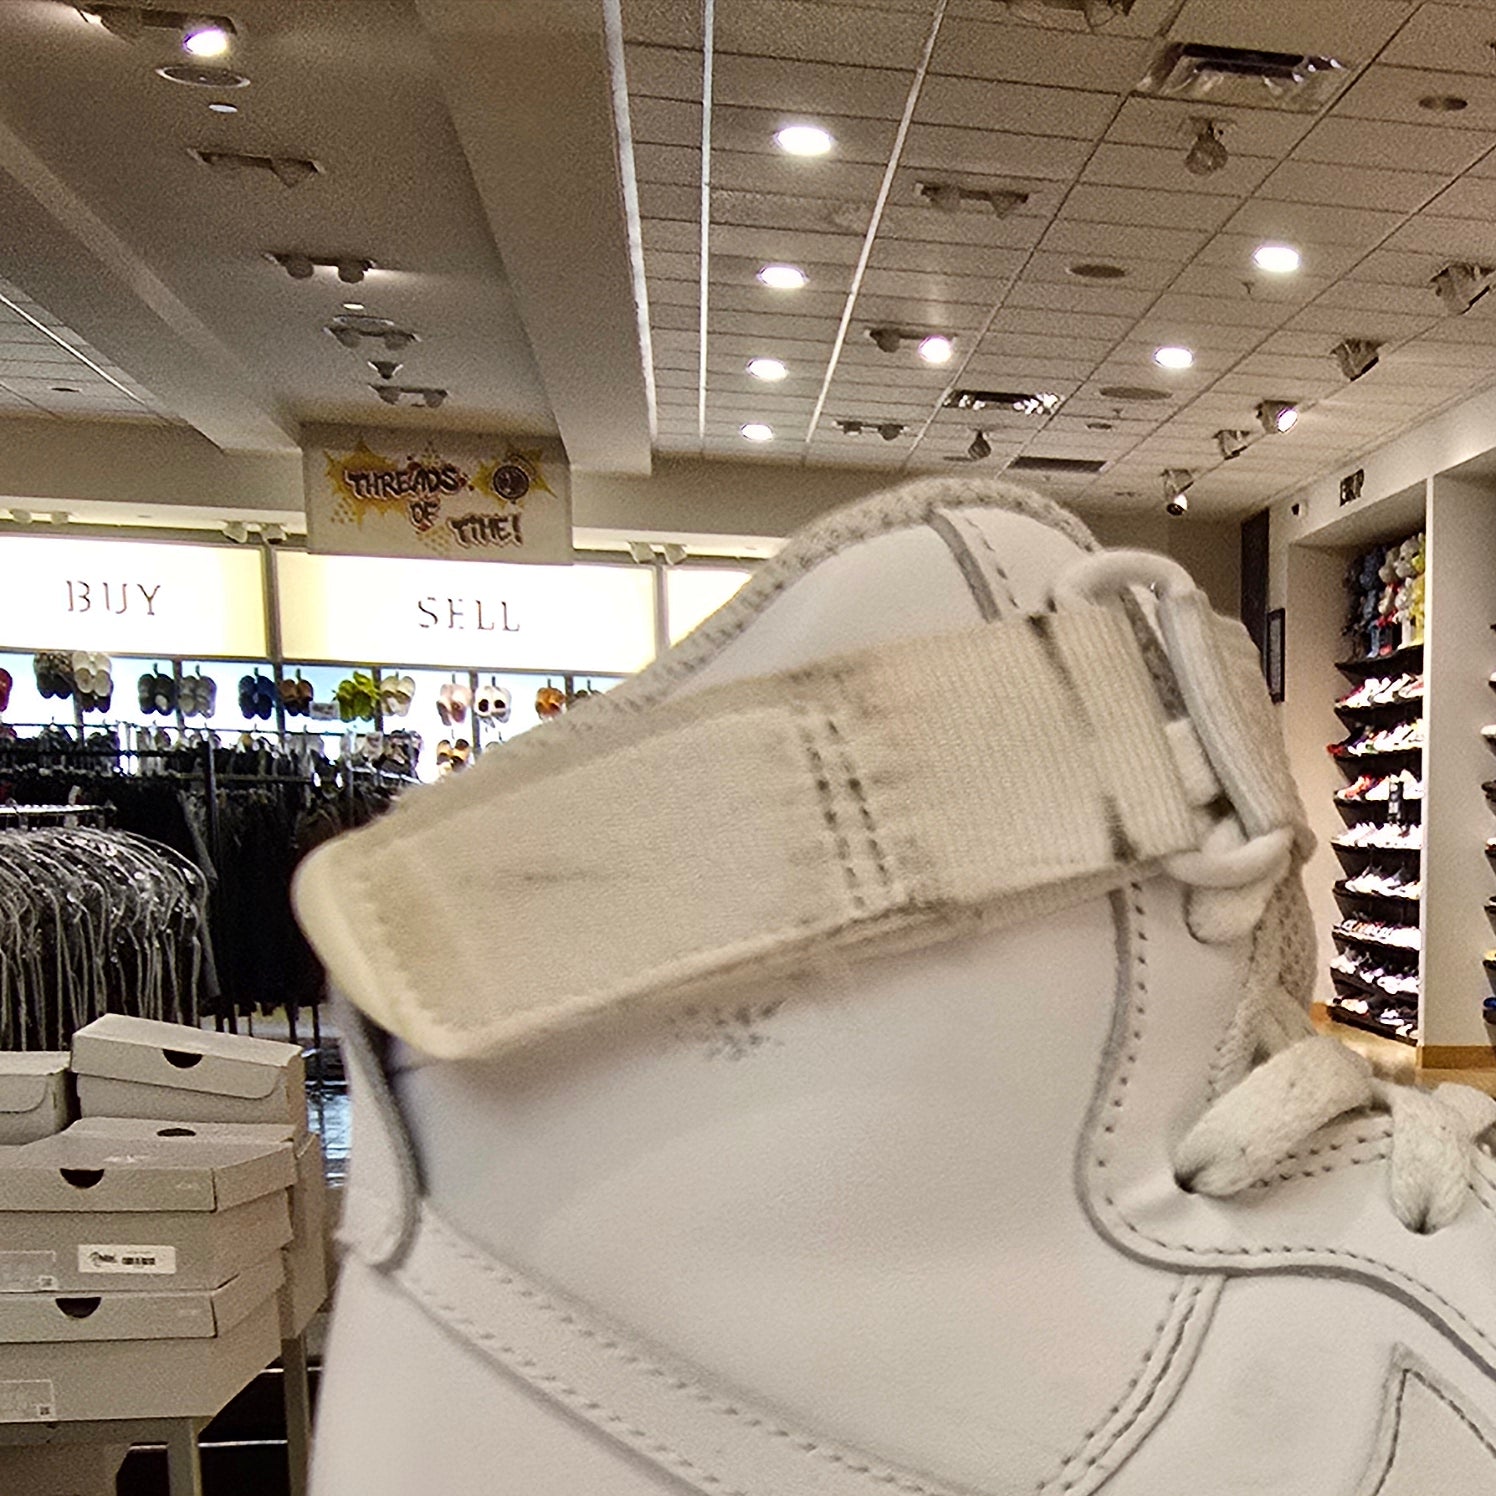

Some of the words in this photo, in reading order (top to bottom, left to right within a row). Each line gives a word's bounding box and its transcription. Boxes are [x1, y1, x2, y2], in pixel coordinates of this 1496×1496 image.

[345, 463, 463, 500] THREADS
[409, 499, 441, 526] OF
[66, 580, 161, 616] BUY
[418, 597, 521, 632] SELL
